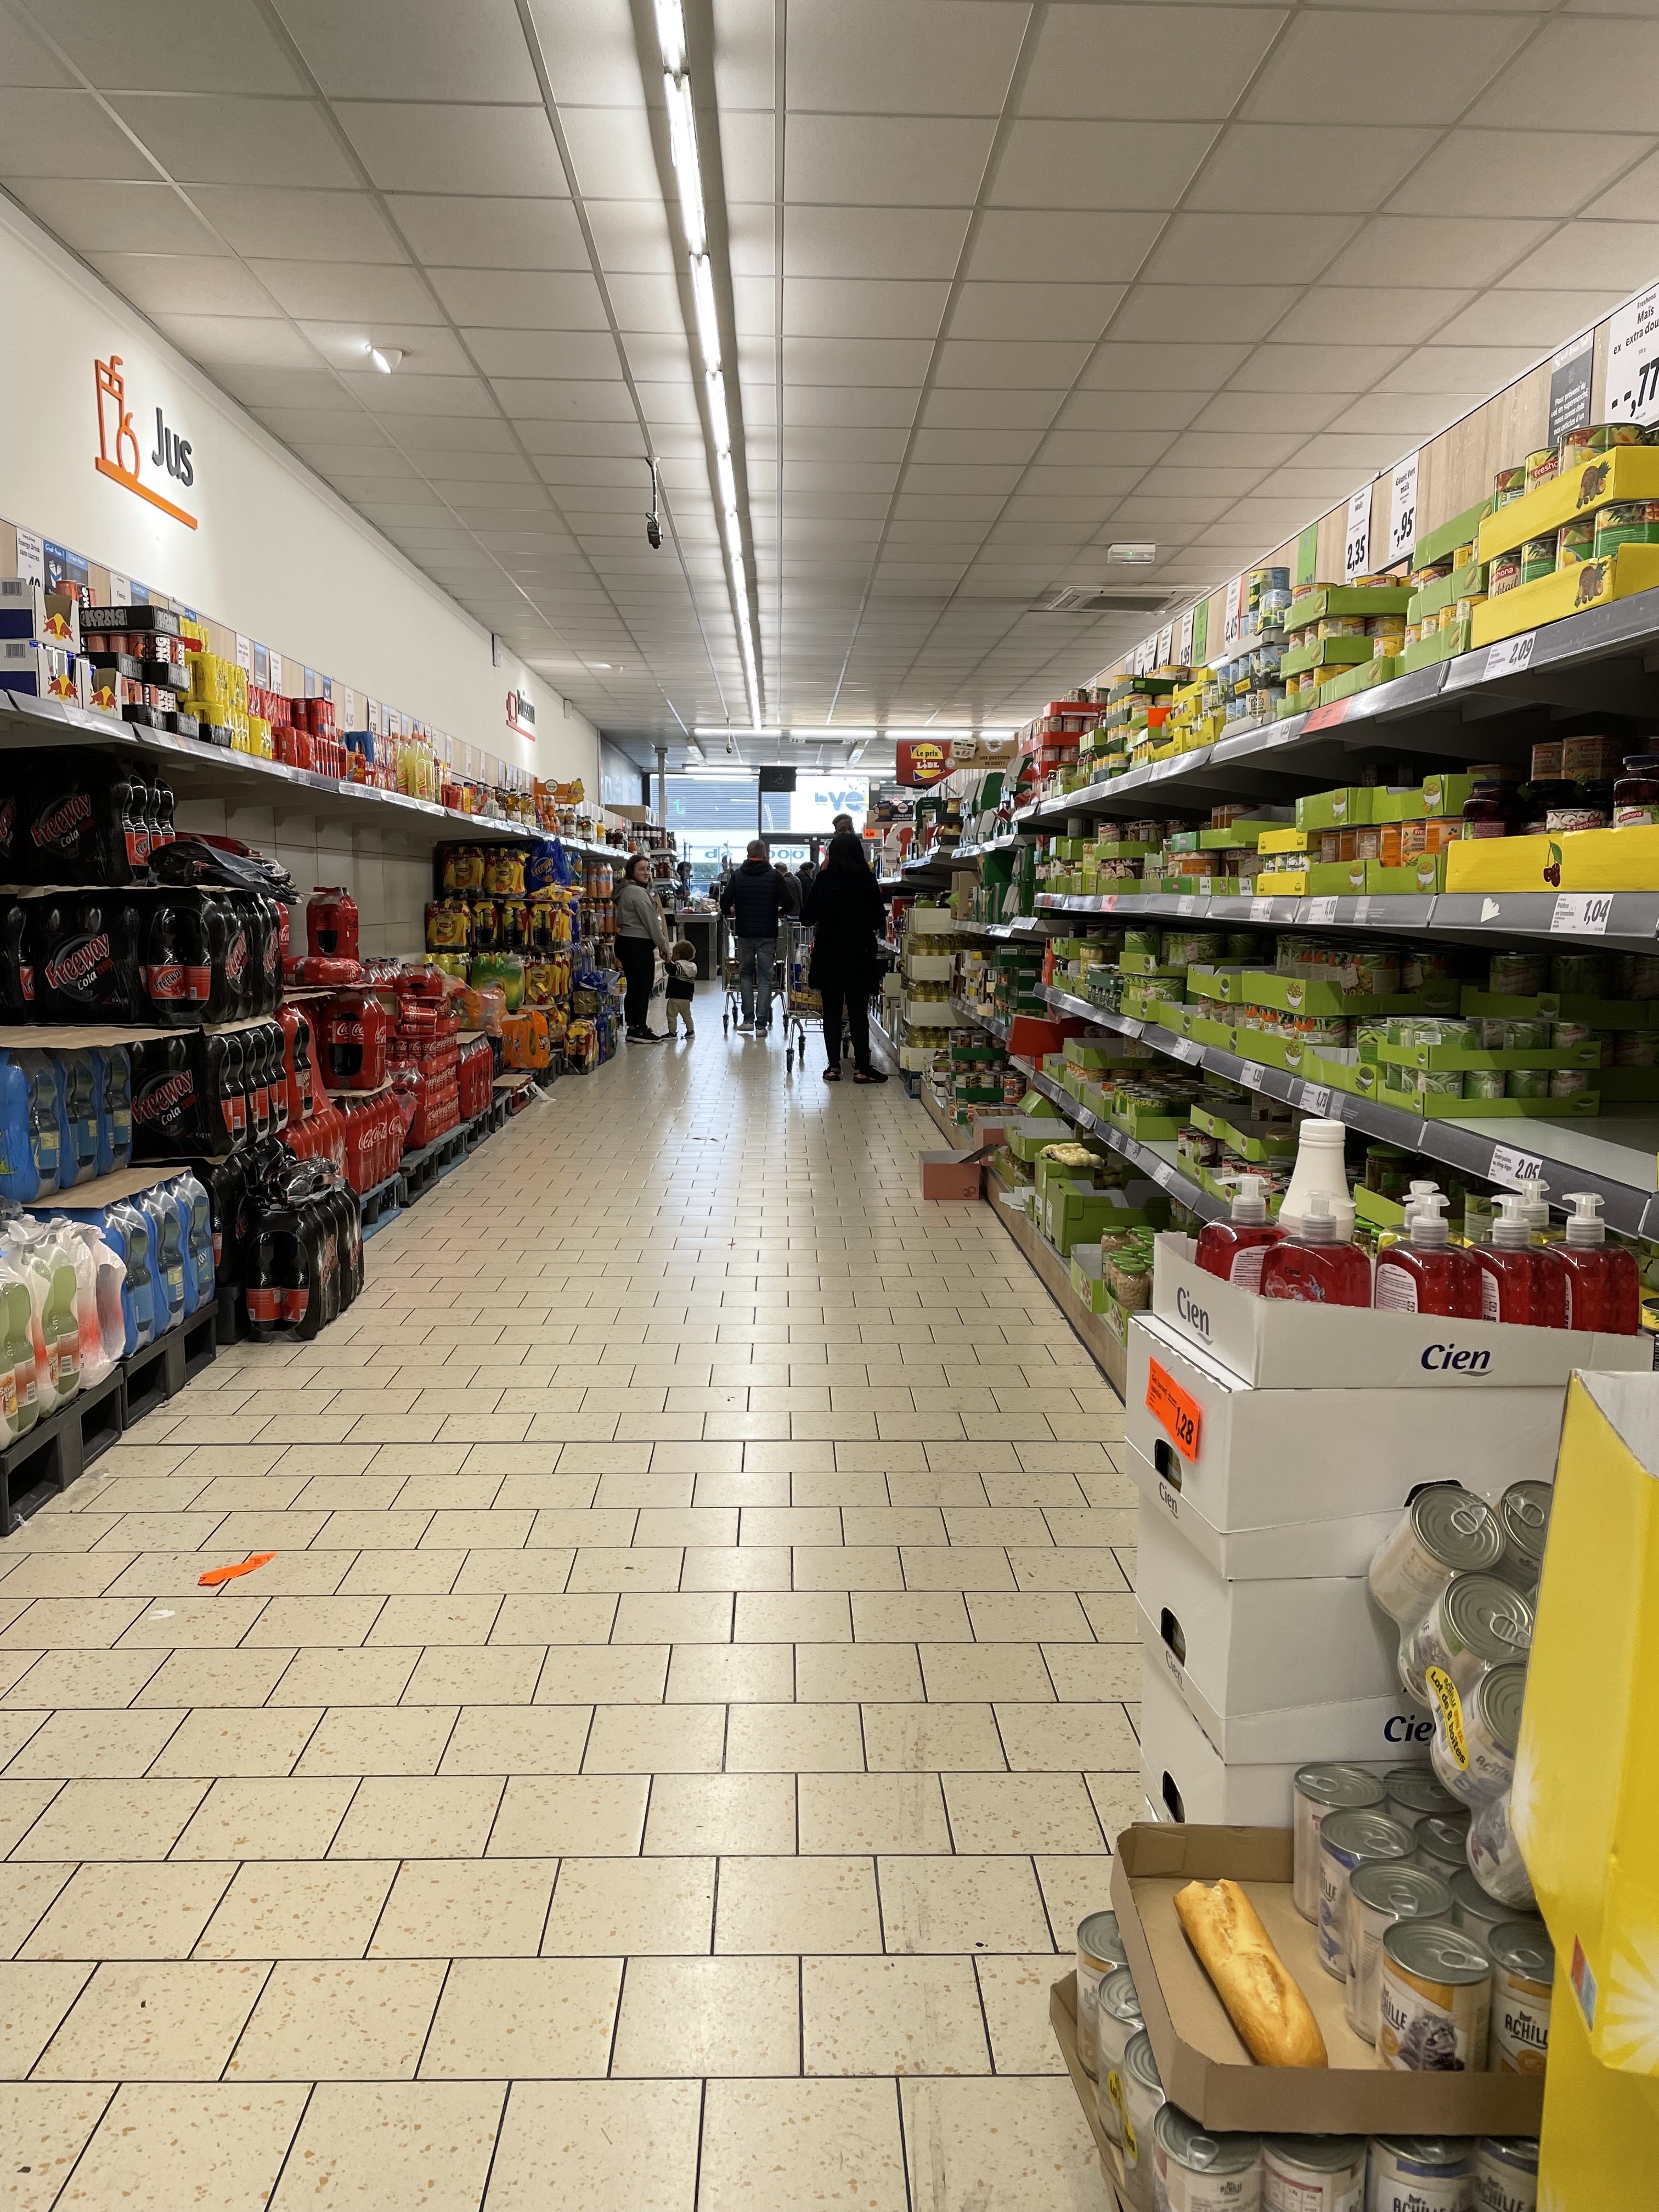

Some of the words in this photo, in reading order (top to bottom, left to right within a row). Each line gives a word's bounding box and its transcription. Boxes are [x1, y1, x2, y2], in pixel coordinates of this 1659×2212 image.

[1637, 292, 1656, 310] Freshona
[1637, 305, 1654, 325] Maïs
[1626, 329, 1644, 347] extra
[1645, 318, 1659, 336] dou
[1555, 395, 1564, 407] Pour
[1565, 385, 1581, 402] prévenir
[1581, 382, 1587, 390] du
[1554, 415, 1564, 426] nous
[1564, 409, 1576, 420] avons
[1561, 418, 1576, 432] articles
[1576, 413, 1584, 424] d'un
[152, 407, 194, 487] Jus
[1396, 473, 1407, 486] Géant
[1534, 460, 1559, 478] Fresho
[1347, 534, 1366, 572] 2,35
[1494, 575, 1519, 597] cktail
[1509, 638, 1533, 665] 2,09
[926, 750, 939, 758] prix
[31, 794, 92, 848] Freeway
[1573, 820, 1601, 831] Freshona
[1620, 810, 1642, 821] Freshona
[60, 829, 80, 848] Cola
[1584, 899, 1611, 926] 1,04
[45, 933, 110, 989] Freeway
[77, 971, 98, 990] Cola
[131, 1069, 193, 1125] Freeway
[160, 1107, 182, 1126] Cola
[1177, 1286, 1210, 1336] Cien
[1421, 1342, 1491, 1370] Cien
[1176, 1406, 1194, 1446] 1,28
[1159, 1481, 1177, 1514] Cien
[1166, 1650, 1182, 1686] Cien
[1431, 1670, 1442, 1694] Lot
[1441, 1692, 1451, 1707] de
[1384, 1714, 1436, 1742] Cie
[1447, 1710, 1452, 1722] 8
[1448, 1722, 1466, 1763] boîtes
[1505, 2012, 1548, 2046] ACHILL
